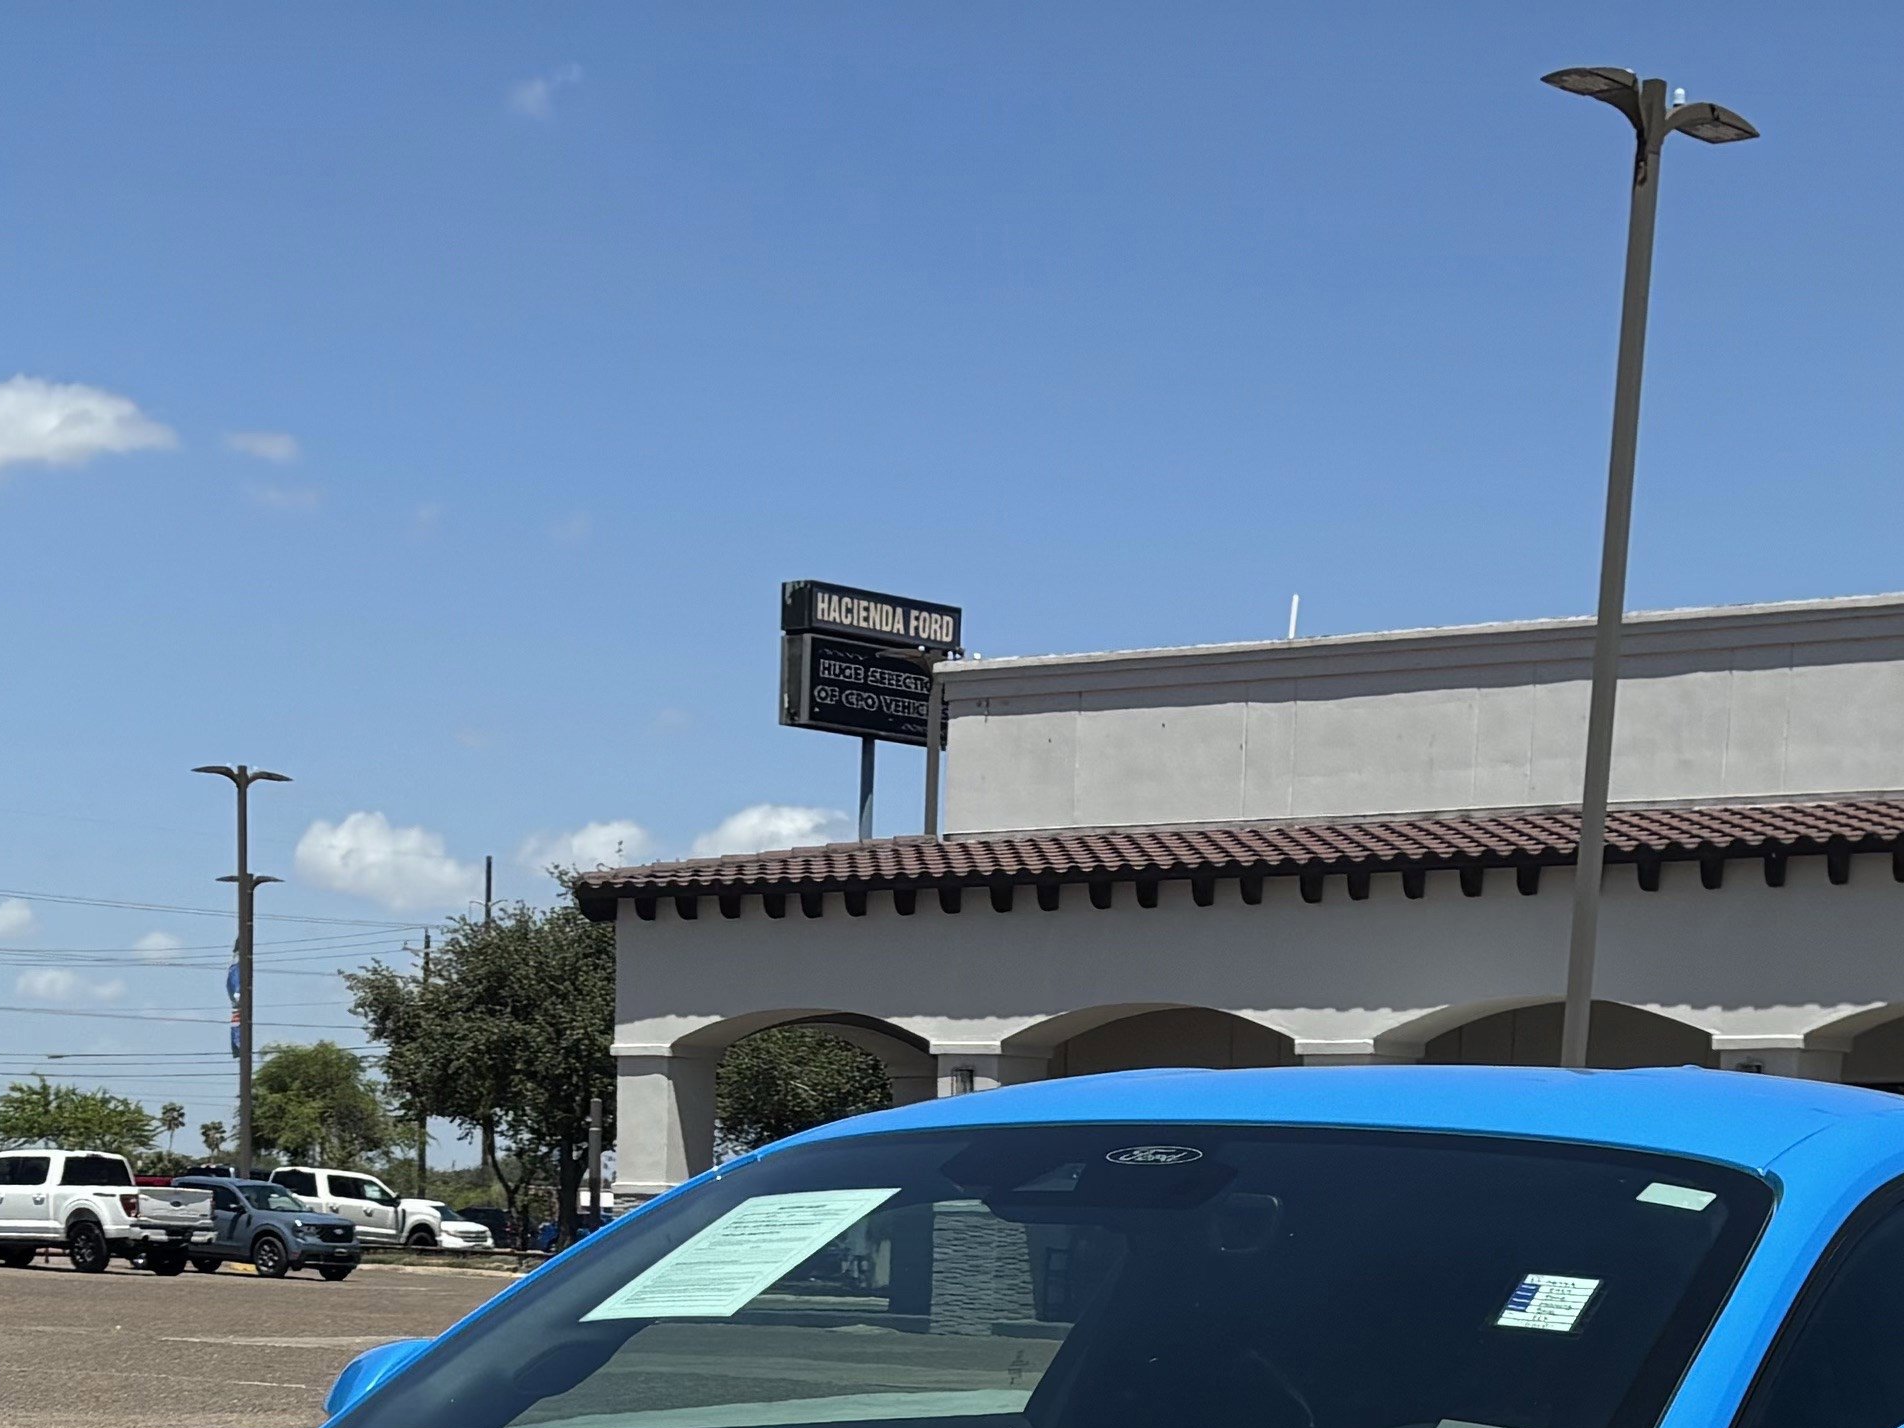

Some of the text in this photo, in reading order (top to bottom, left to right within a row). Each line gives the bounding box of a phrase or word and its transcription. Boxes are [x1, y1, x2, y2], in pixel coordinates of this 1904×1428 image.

[816, 592, 954, 642] HACIENDA FORD
[819, 658, 865, 683] HUGE
[813, 685, 840, 705] OF
[841, 689, 879, 711] CPO
